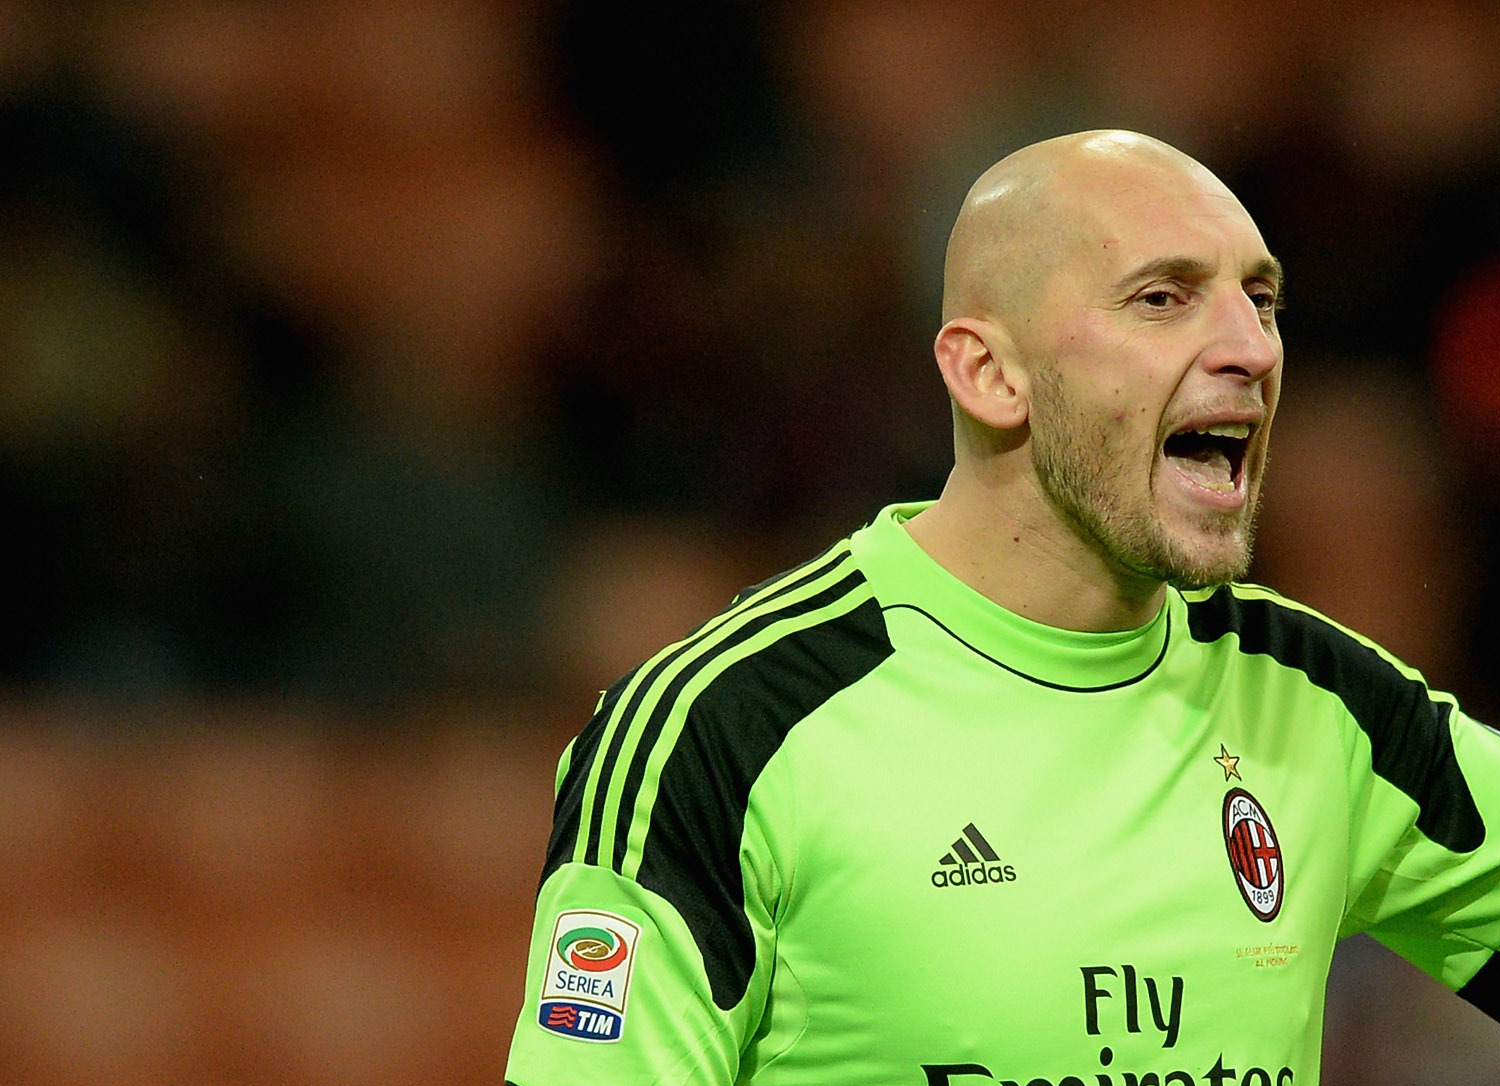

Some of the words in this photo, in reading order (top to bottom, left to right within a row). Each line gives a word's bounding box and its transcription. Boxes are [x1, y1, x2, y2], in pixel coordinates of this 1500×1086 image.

[1232, 799, 1261, 824] ACM
[931, 862, 1017, 888] adidas
[1251, 889, 1275, 904] 1899
[555, 970, 602, 996] SERIE
[601, 979, 614, 998] A
[1080, 964, 1184, 1049] Fly
[577, 1010, 614, 1036] TIM
